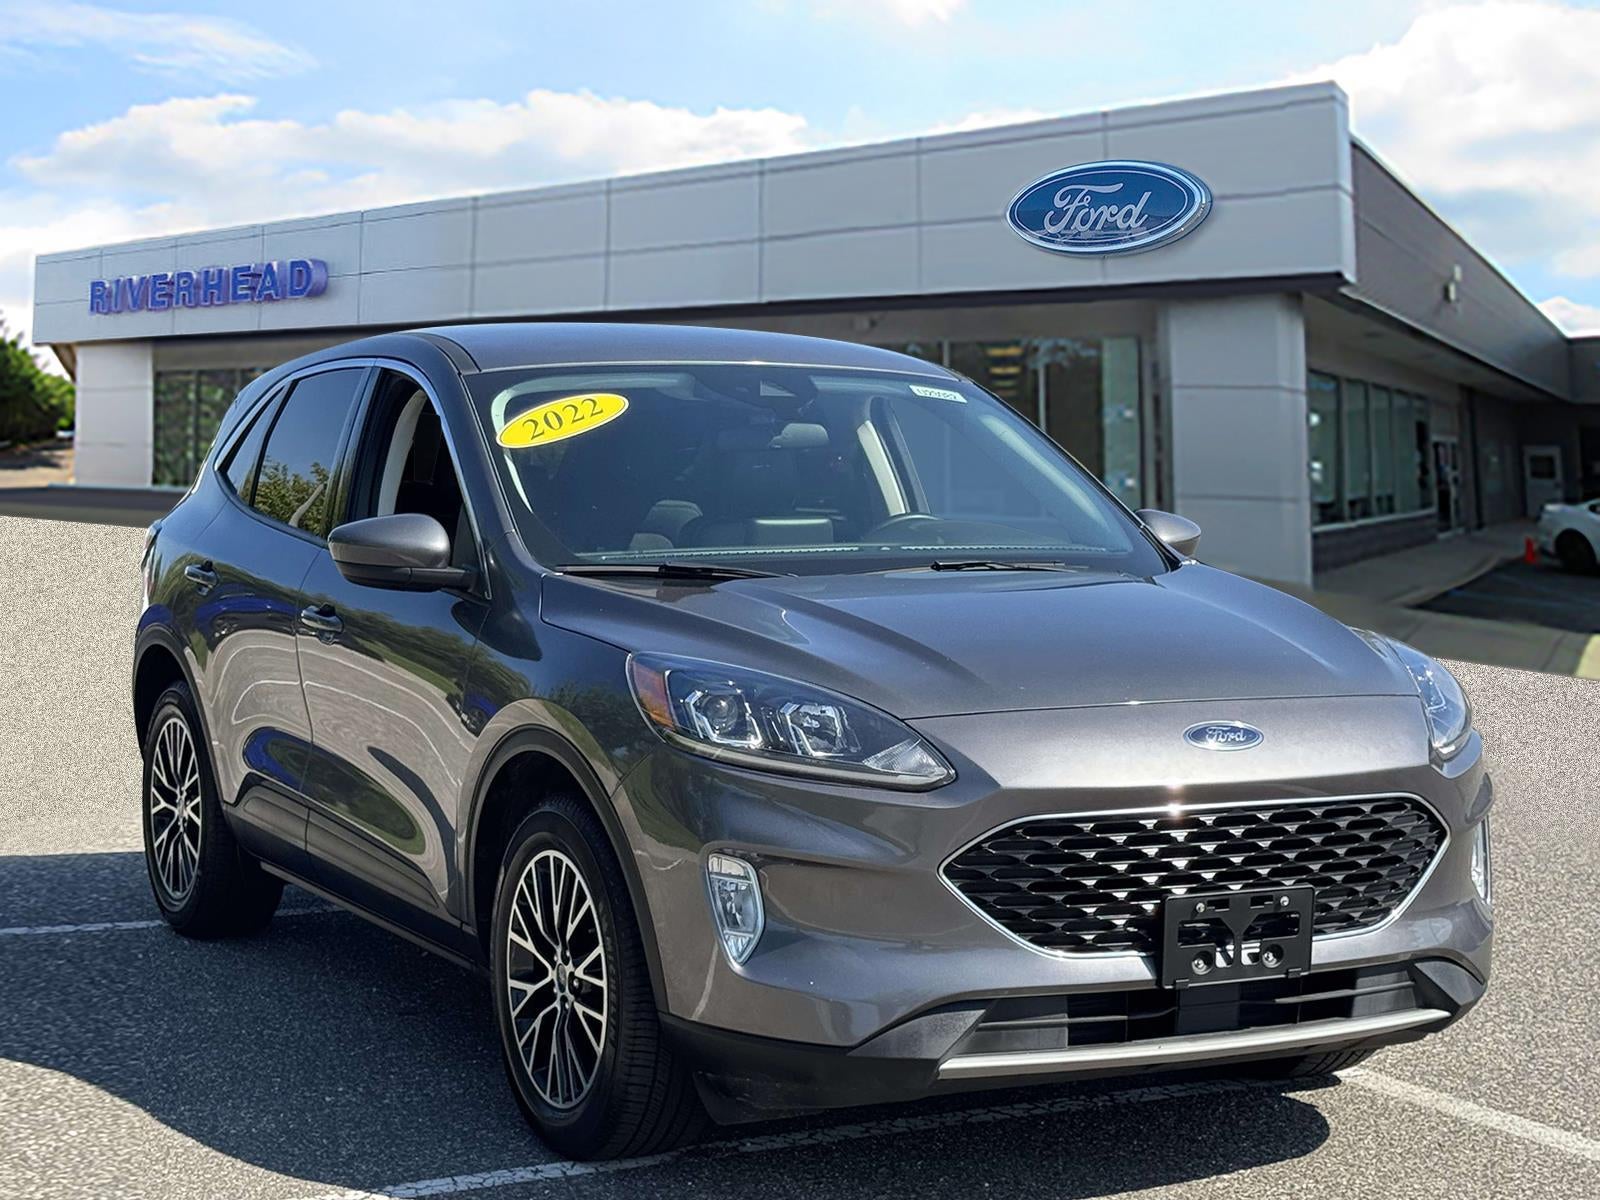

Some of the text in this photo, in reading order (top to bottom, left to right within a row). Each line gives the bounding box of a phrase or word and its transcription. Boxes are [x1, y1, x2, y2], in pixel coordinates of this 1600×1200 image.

[1043, 182, 1152, 234] Ford
[89, 259, 324, 315] RIVERHEAD
[522, 398, 604, 440] 2022
[1205, 726, 1248, 743] Ford
